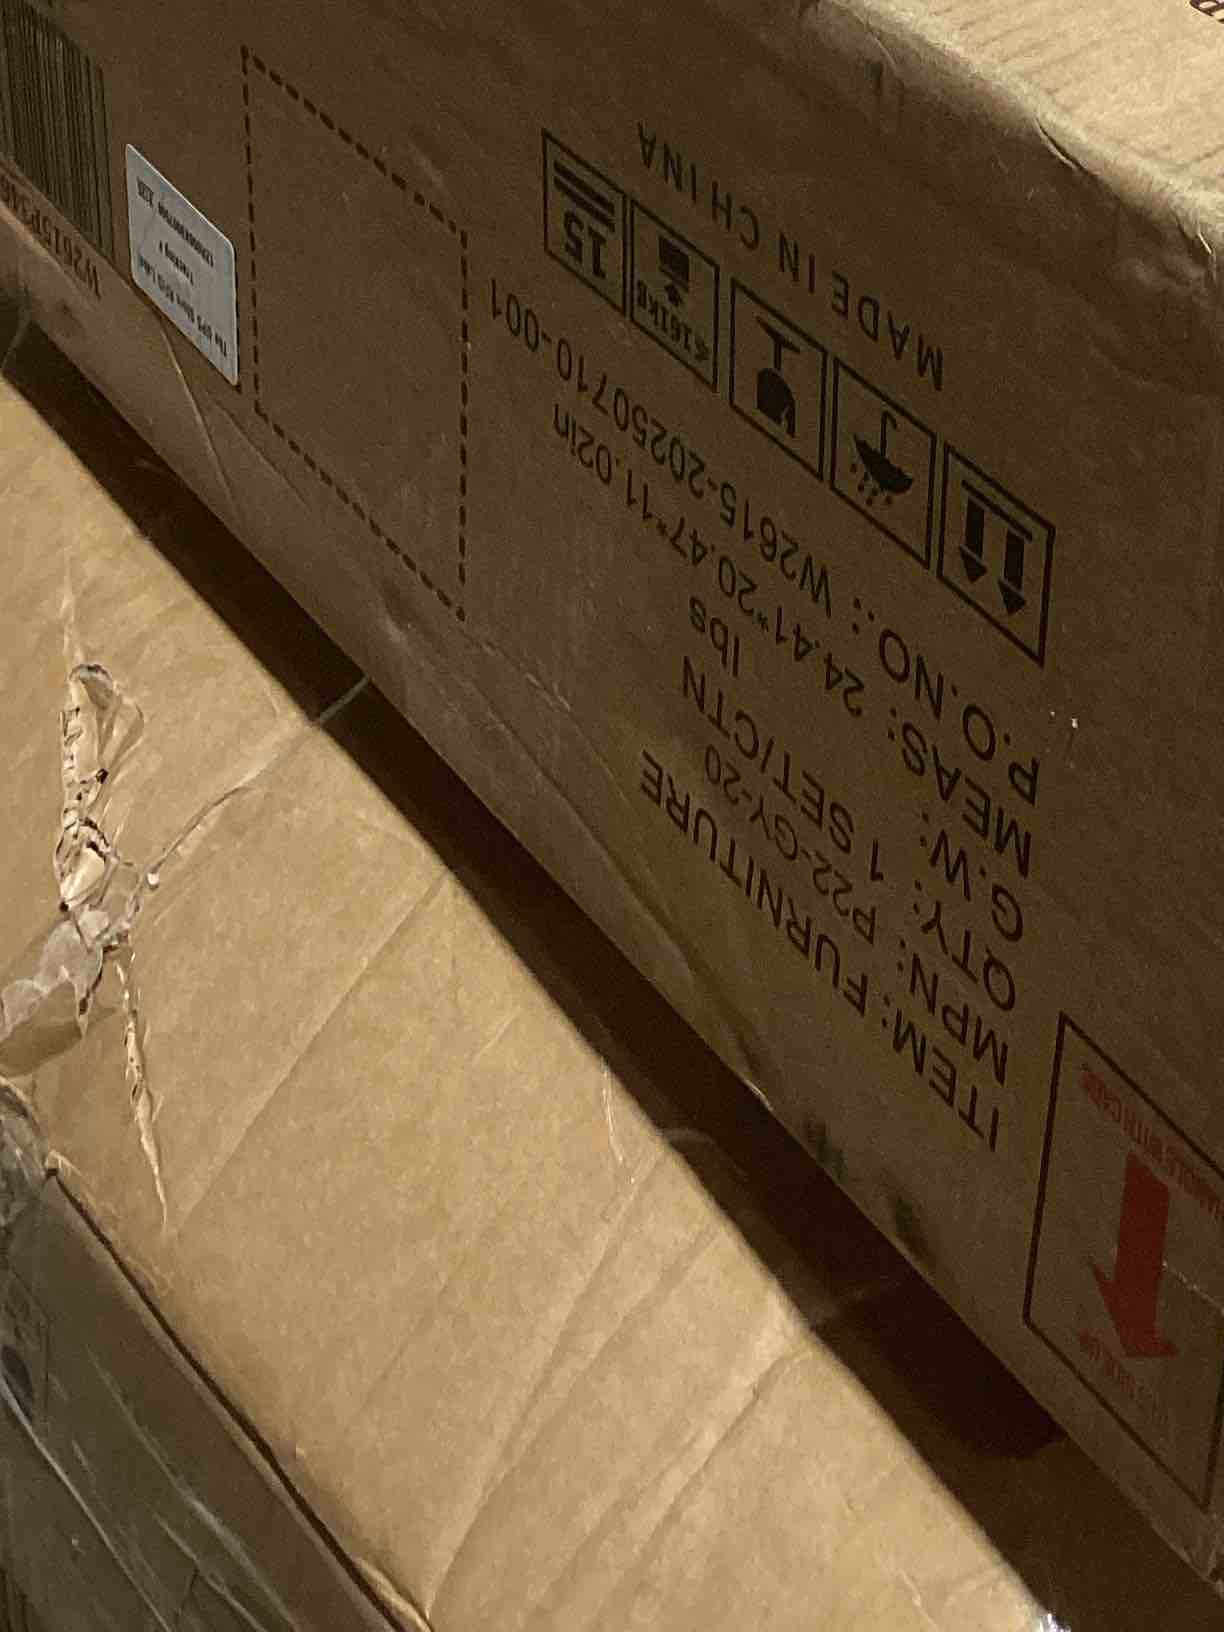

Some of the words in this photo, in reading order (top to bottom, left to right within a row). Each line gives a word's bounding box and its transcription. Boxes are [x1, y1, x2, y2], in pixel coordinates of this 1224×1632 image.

[636, 121, 761, 252] CHINA
[778, 231, 816, 295] IN
[831, 272, 945, 393] MADE
[488, 277, 833, 621] W2615-20250710-001
[687, 595, 741, 679] lbs
[679, 652, 857, 857] SET/CTN
[886, 707, 1032, 881] MEAS:
[637, 747, 871, 1021] FURNITURE
[702, 743, 878, 947] P22-GY-20
[867, 839, 885, 882] 1
[918, 811, 1025, 947] G.W.:
[894, 938, 1010, 1089] MPN:
[911, 878, 1017, 1015] QTY:
[879, 990, 1001, 1153] ITEM:
